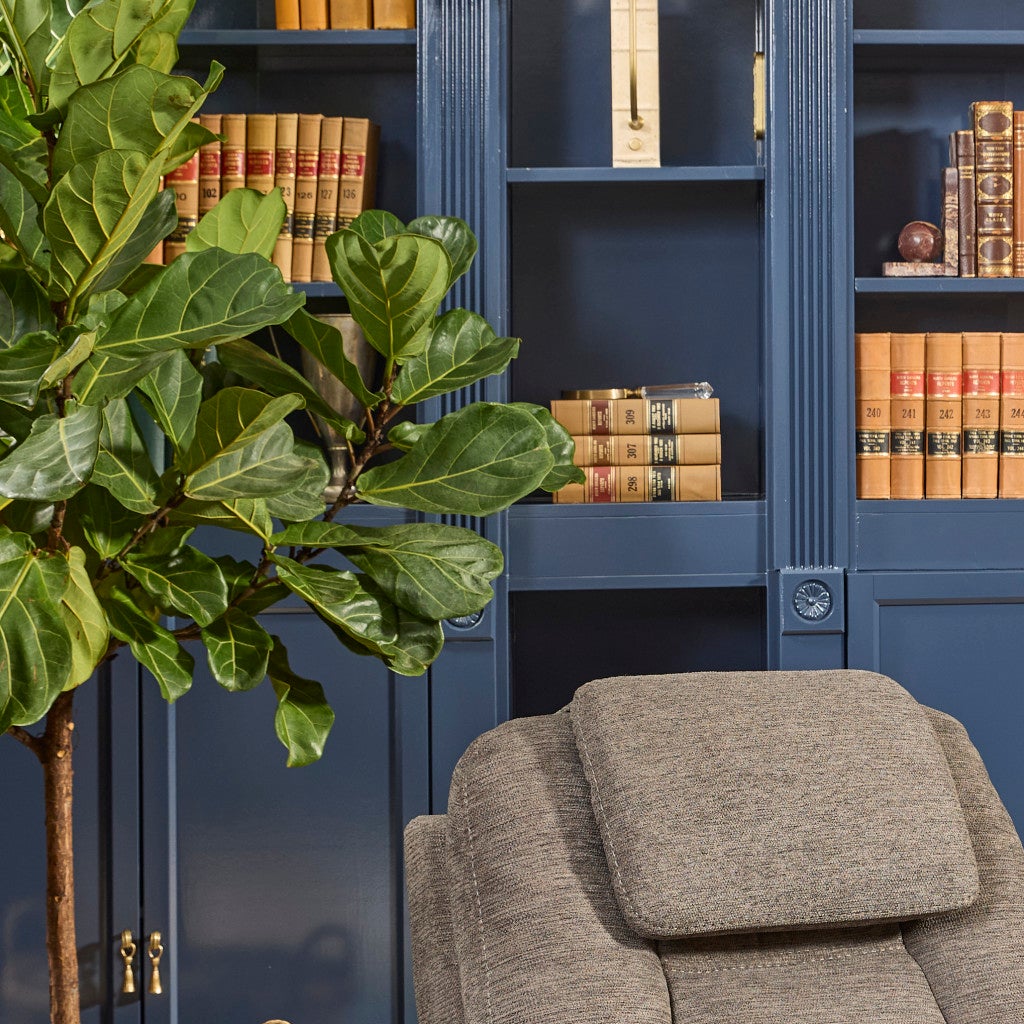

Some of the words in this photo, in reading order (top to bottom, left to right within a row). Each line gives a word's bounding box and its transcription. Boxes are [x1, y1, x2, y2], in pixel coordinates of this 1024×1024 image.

[202, 187, 217, 199] 102
[320, 189, 334, 200] 127
[625, 409, 635, 425] 309
[866, 407, 881, 418] 240
[902, 408, 916, 419] 241
[939, 408, 954, 419] 242
[975, 408, 991, 419] 243
[627, 443, 637, 459] 307
[628, 476, 638, 492] 298
